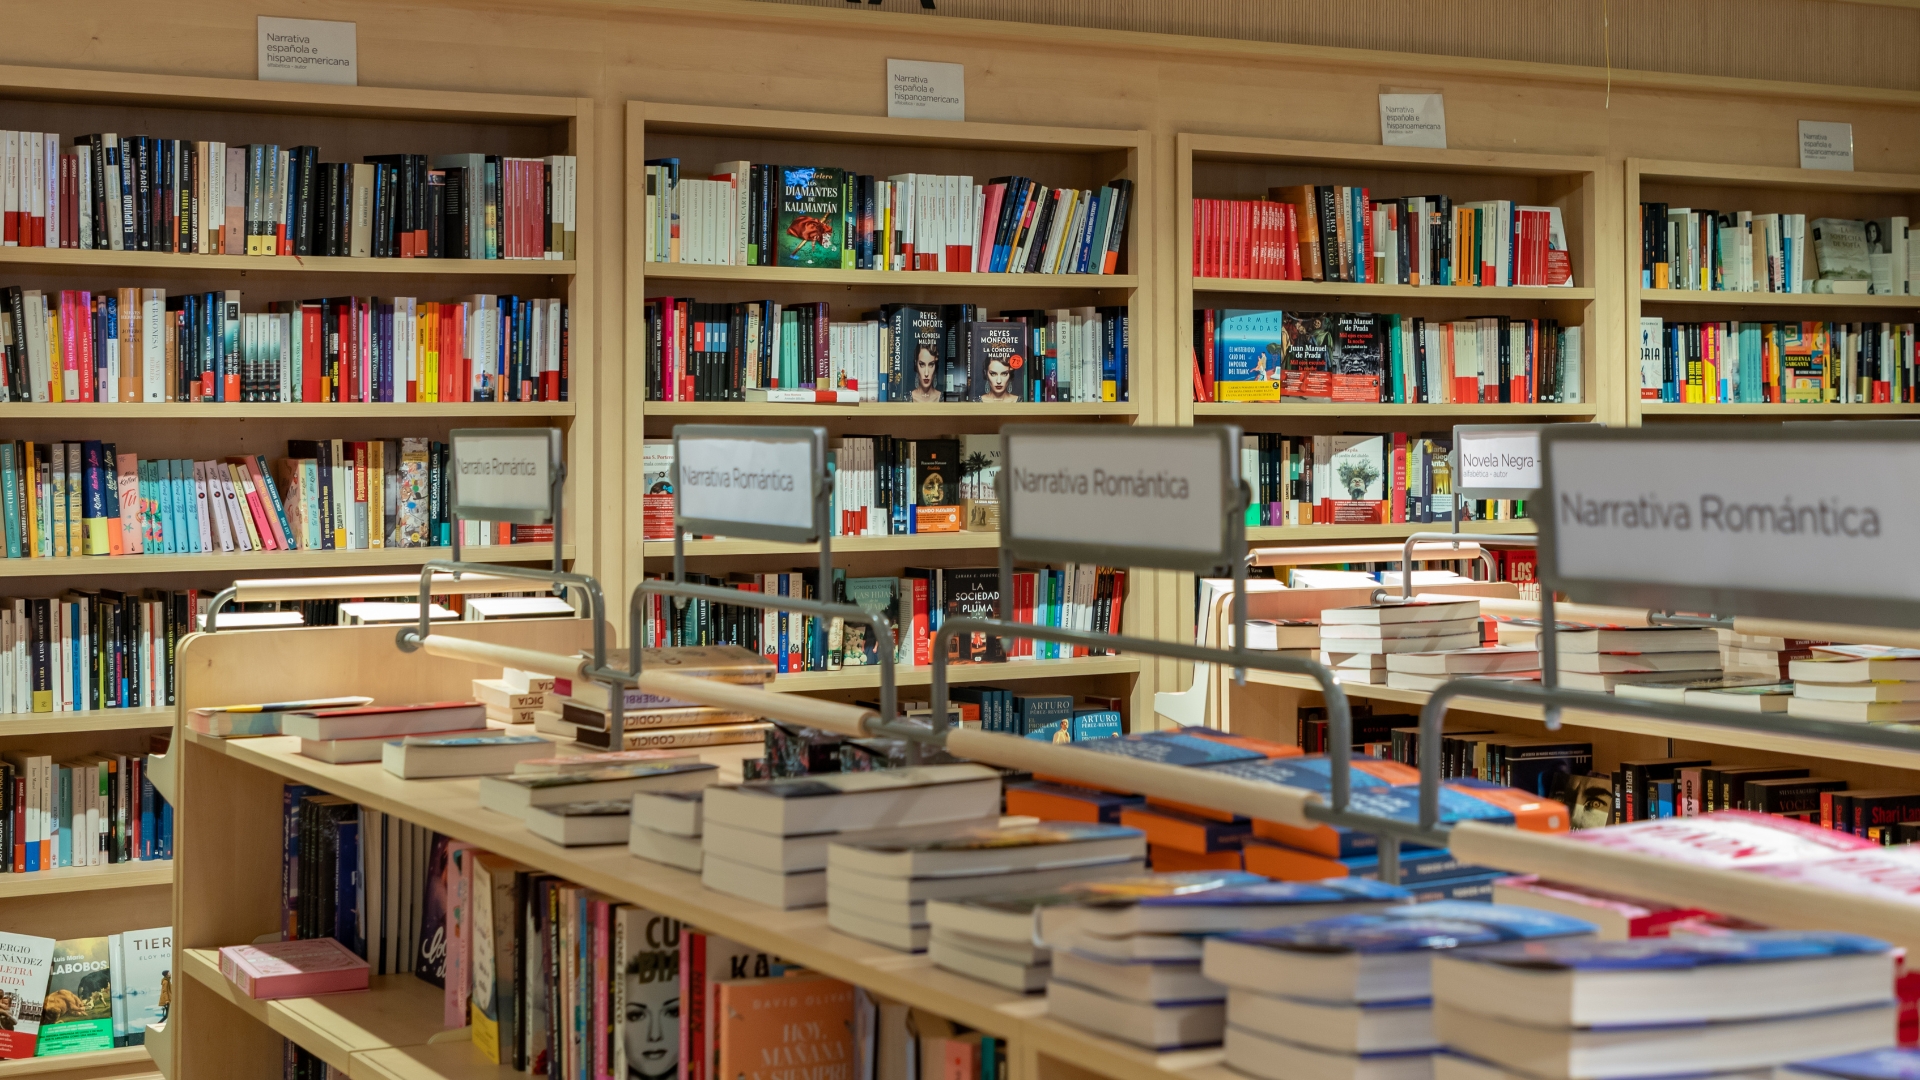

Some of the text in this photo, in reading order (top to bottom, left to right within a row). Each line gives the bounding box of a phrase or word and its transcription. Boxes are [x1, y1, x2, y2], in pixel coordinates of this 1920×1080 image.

[267, 33, 310, 44] Narrativa
[267, 44, 310, 56] española
[267, 53, 350, 66] hispanoamericana
[894, 74, 928, 84] Narrativa
[894, 84, 928, 93] española
[894, 92, 959, 104] hispanoamericana
[1385, 105, 1414, 114] Narrativa
[1386, 114, 1414, 123] española
[1386, 121, 1441, 130] hispanoamericana
[1803, 133, 1828, 141] Narrativa
[1804, 141, 1828, 149] española
[1804, 148, 1849, 157] hispanoamericana
[140, 169, 149, 193] PARÍS
[785, 185, 838, 198] DIAMANTES
[124, 195, 134, 225] DIPUTADO
[739, 191, 748, 230] PANCARTA
[785, 201, 838, 214] KALIMANTÁN
[1328, 191, 1337, 233] ARTURO
[1830, 233, 1862, 243] SOSPECHA
[1327, 237, 1335, 266] FUEGO
[919, 311, 937, 320] REYES
[1229, 316, 1278, 324] CARMEN
[1338, 317, 1374, 326] Juan Manuel
[912, 319, 943, 328] MONFORTE
[1229, 324, 1278, 332] POSADAS
[980, 336, 1019, 344] MONFORTE
[1289, 344, 1327, 353] Juan Manuel
[4, 448, 12, 474] BARRIO
[456, 457, 537, 477] Narrativa Romántica
[1463, 453, 1534, 470] Novela Negra
[432, 474, 438, 482] LA
[681, 466, 795, 492] Narrativa Romántica
[1013, 466, 1191, 500] Narrativa Romántica
[5, 480, 14, 504] CHICAS
[268, 484, 278, 499] MARTES
[357, 471, 366, 501] Persiguiendo
[274, 499, 282, 512] CINCO
[1561, 492, 1881, 538] Narrativa Romántica
[1511, 561, 1533, 582] LOS
[971, 582, 984, 591] LA
[955, 591, 1000, 601] SOCIEDAD
[962, 604, 993, 613] PLUMA
[39, 654, 44, 662] LA
[1030, 701, 1070, 711] ARTURO
[1081, 714, 1118, 723] ARTURO
[630, 734, 675, 747] CODICIA
[1625, 770, 1633, 794] KEPLER
[1685, 779, 1693, 812] CHICAS
[1779, 799, 1816, 811] VOCES
[1871, 805, 1900, 825] Shari
[133, 936, 172, 951] TIER
[616, 922, 624, 1025] CUORE BIANCO
[752, 997, 798, 1010] DAVID
[762, 1039, 845, 1067] MAÑANA
